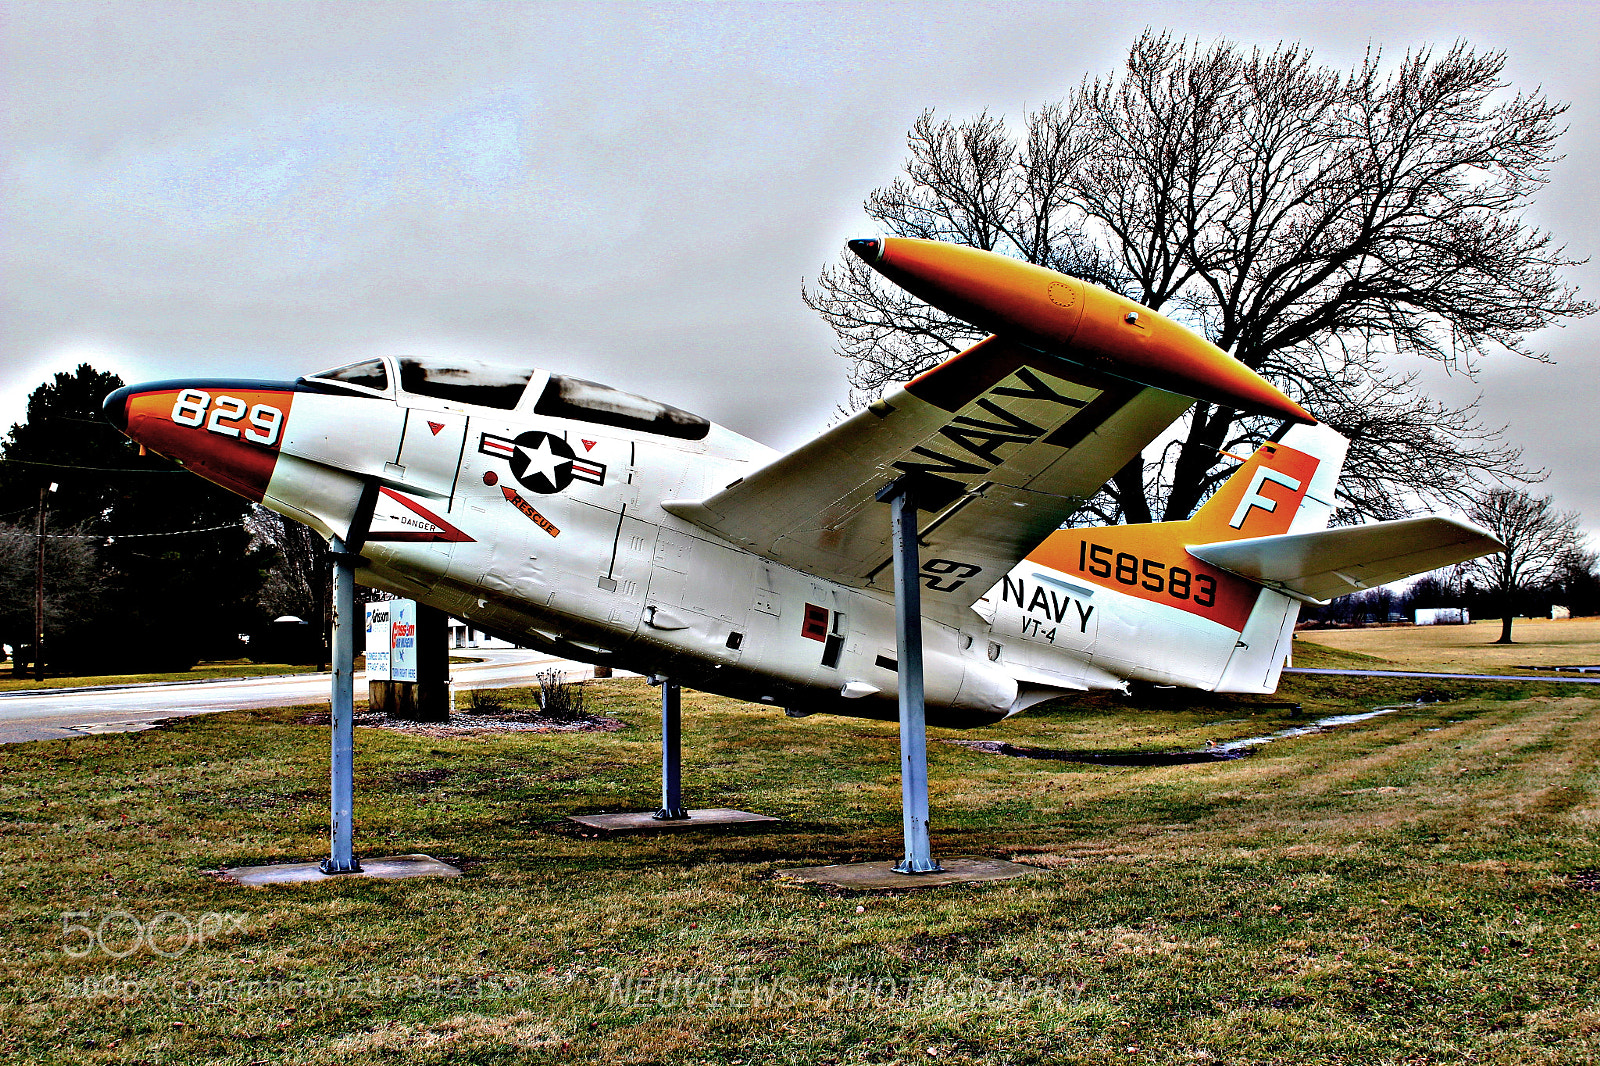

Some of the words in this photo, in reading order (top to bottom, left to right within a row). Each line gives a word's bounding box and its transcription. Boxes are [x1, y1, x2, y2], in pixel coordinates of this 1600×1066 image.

[170, 388, 284, 447] 829
[890, 367, 1090, 487] NAVY
[401, 516, 436, 532] DANGER
[511, 496, 555, 534] RESCUE
[1229, 465, 1301, 531] F
[1079, 540, 1217, 608] 158583
[1002, 574, 1095, 634] NAVY
[1021, 615, 1058, 644] VT-4
